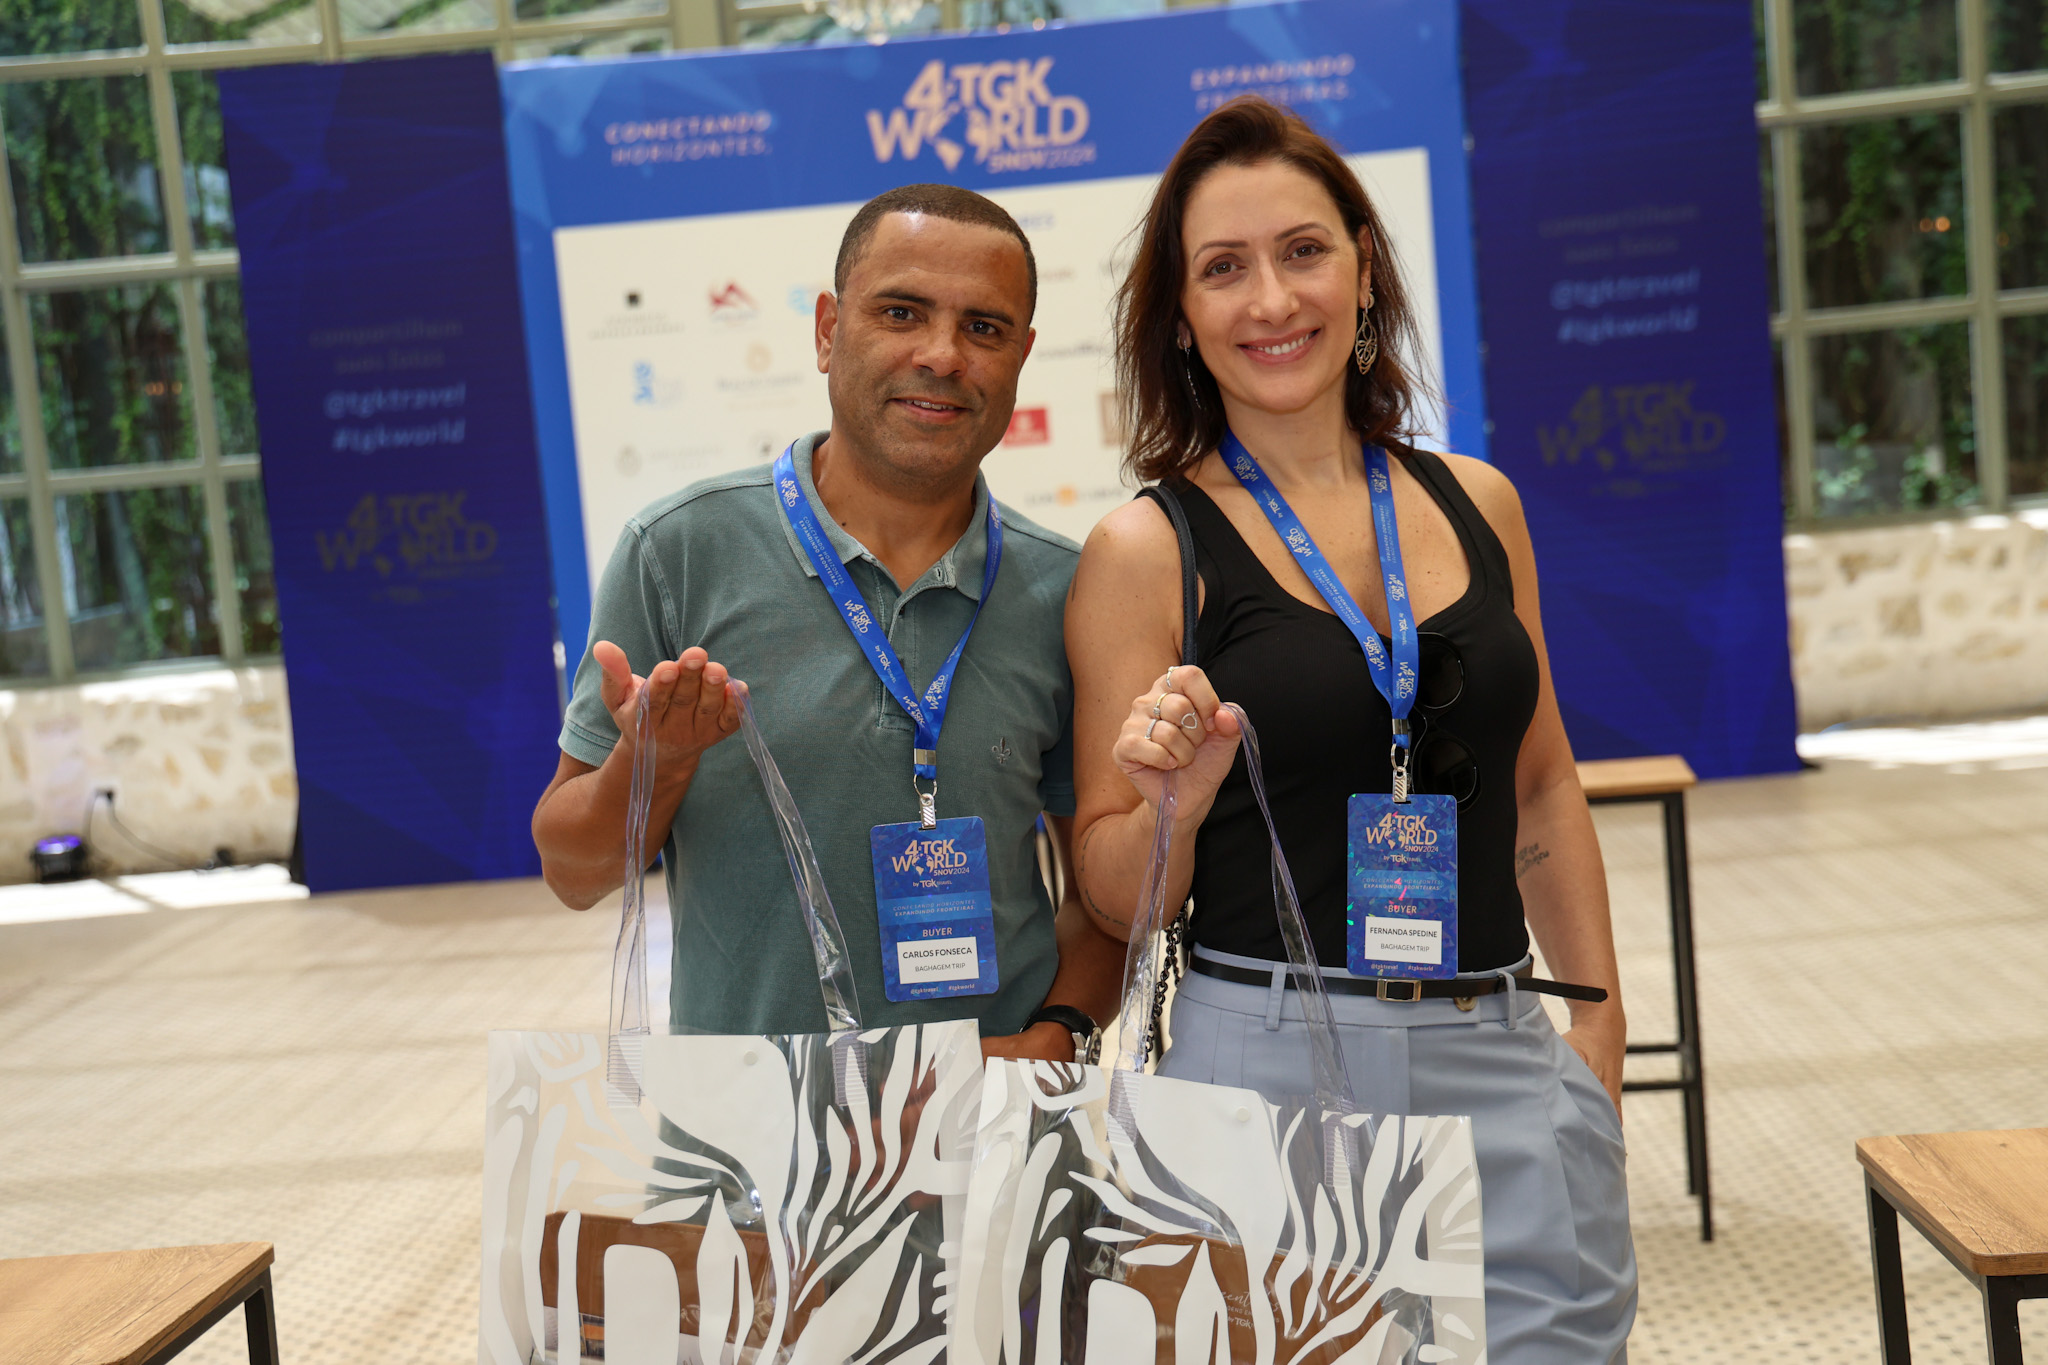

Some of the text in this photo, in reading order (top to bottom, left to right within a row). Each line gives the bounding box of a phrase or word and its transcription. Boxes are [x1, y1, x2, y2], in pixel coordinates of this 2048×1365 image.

[1191, 54, 1355, 92] EXPANDINDO
[604, 111, 772, 145] CONECTANDO
[798, 520, 820, 553] EXPANDINDO
[803, 515, 825, 551] CONECTANDO
[1394, 815, 1428, 831] TGK
[920, 838, 956, 855] TGK
[895, 909, 935, 917] EXPANDINDO
[1388, 905, 1417, 914] BUYER
[922, 927, 953, 938] BUYER
[1370, 926, 1438, 938] FERNANDA SPEDINE
[902, 947, 973, 959] CARLOS FONSECA
[1380, 943, 1415, 952] BAGHAGEM
[915, 963, 952, 972] BAGHAGEM
[948, 983, 975, 992] #tgkworld
